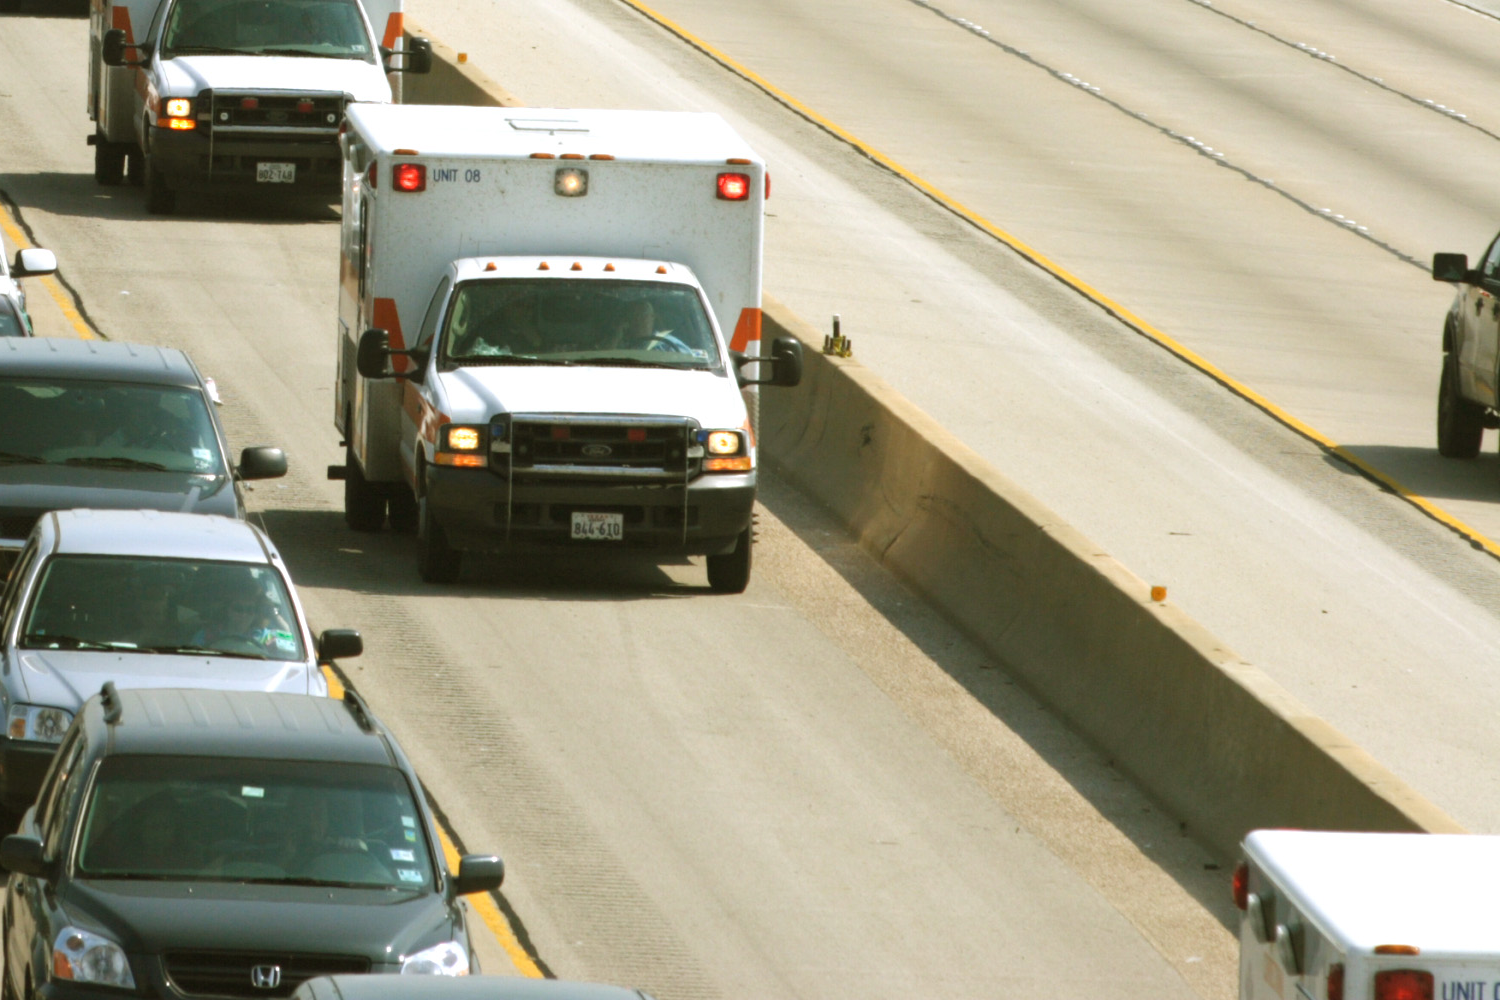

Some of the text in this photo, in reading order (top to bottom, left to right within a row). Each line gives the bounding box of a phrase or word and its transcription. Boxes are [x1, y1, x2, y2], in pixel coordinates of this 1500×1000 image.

[433, 168, 481, 183] UNIT 08
[1442, 981, 1487, 1000] UNIT
